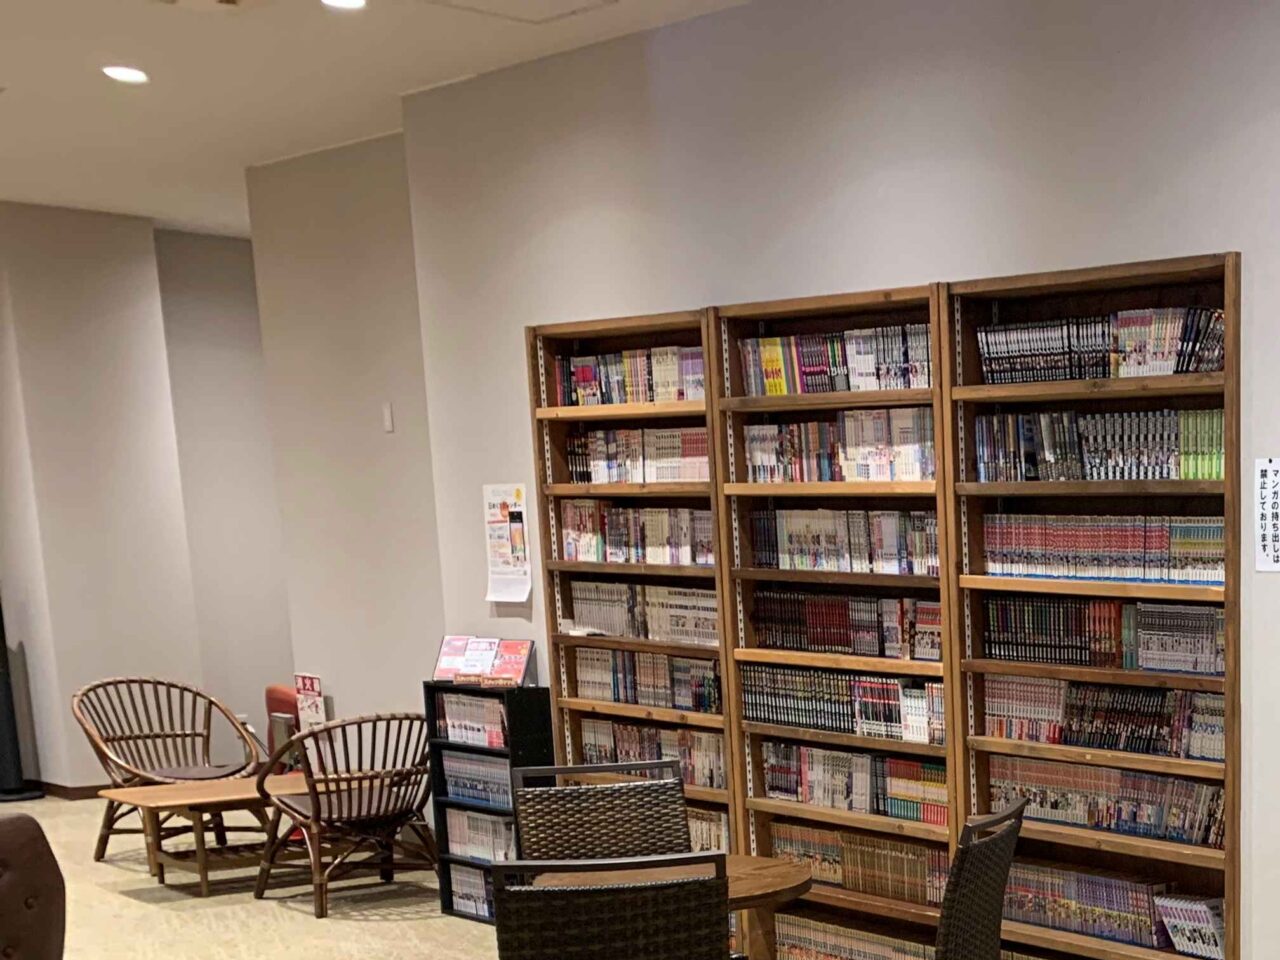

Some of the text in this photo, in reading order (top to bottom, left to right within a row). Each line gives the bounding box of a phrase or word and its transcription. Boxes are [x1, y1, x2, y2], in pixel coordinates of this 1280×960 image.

[1260, 469, 1269, 557] 禁止しております。
[1271, 469, 1280, 564] マンガの持ち出しは
